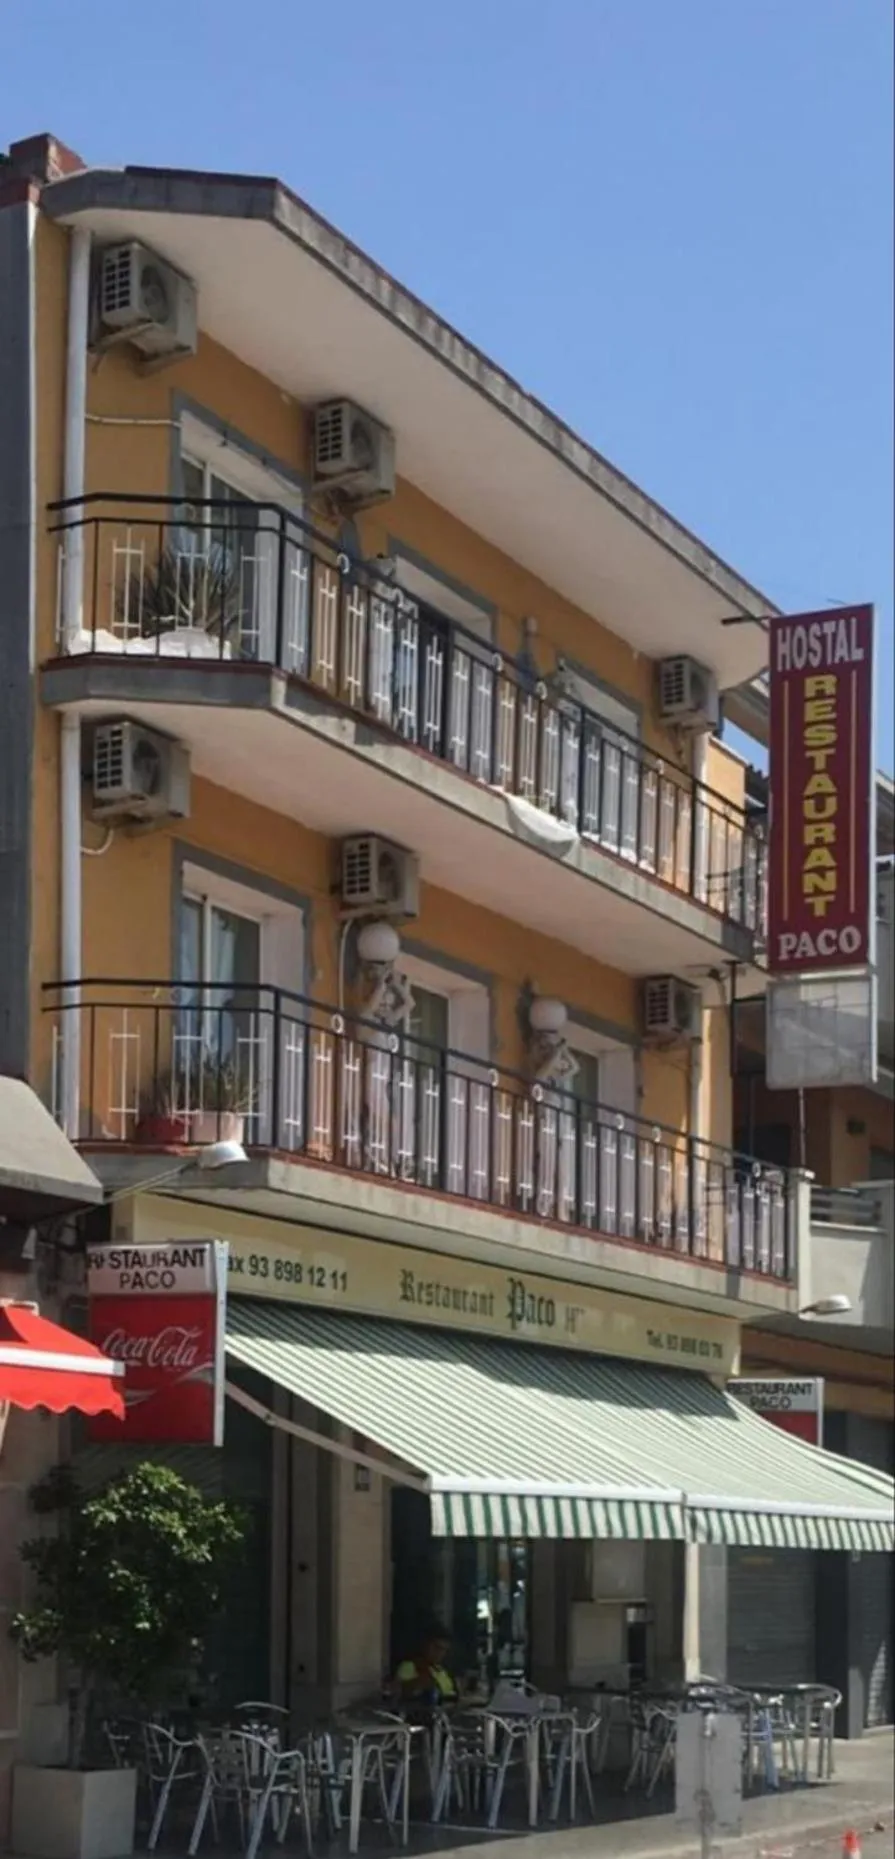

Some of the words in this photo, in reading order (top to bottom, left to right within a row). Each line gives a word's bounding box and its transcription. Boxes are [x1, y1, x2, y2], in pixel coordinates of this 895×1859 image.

[776, 616, 864, 672] HOSTAL
[803, 673, 838, 917] RESTAURANT
[778, 925, 861, 960] PACO
[119, 1269, 176, 1290] PACO
[249, 1254, 269, 1278] 93
[274, 1258, 303, 1284] 898
[307, 1265, 326, 1288] 12
[329, 1269, 348, 1292] 11
[400, 1268, 495, 1317] Restaurant
[506, 1276, 556, 1330] Paco
[102, 1325, 203, 1368] Coca-Cola
[726, 1382, 812, 1395] RESTAURANT
[749, 1395, 792, 1409] PACO
